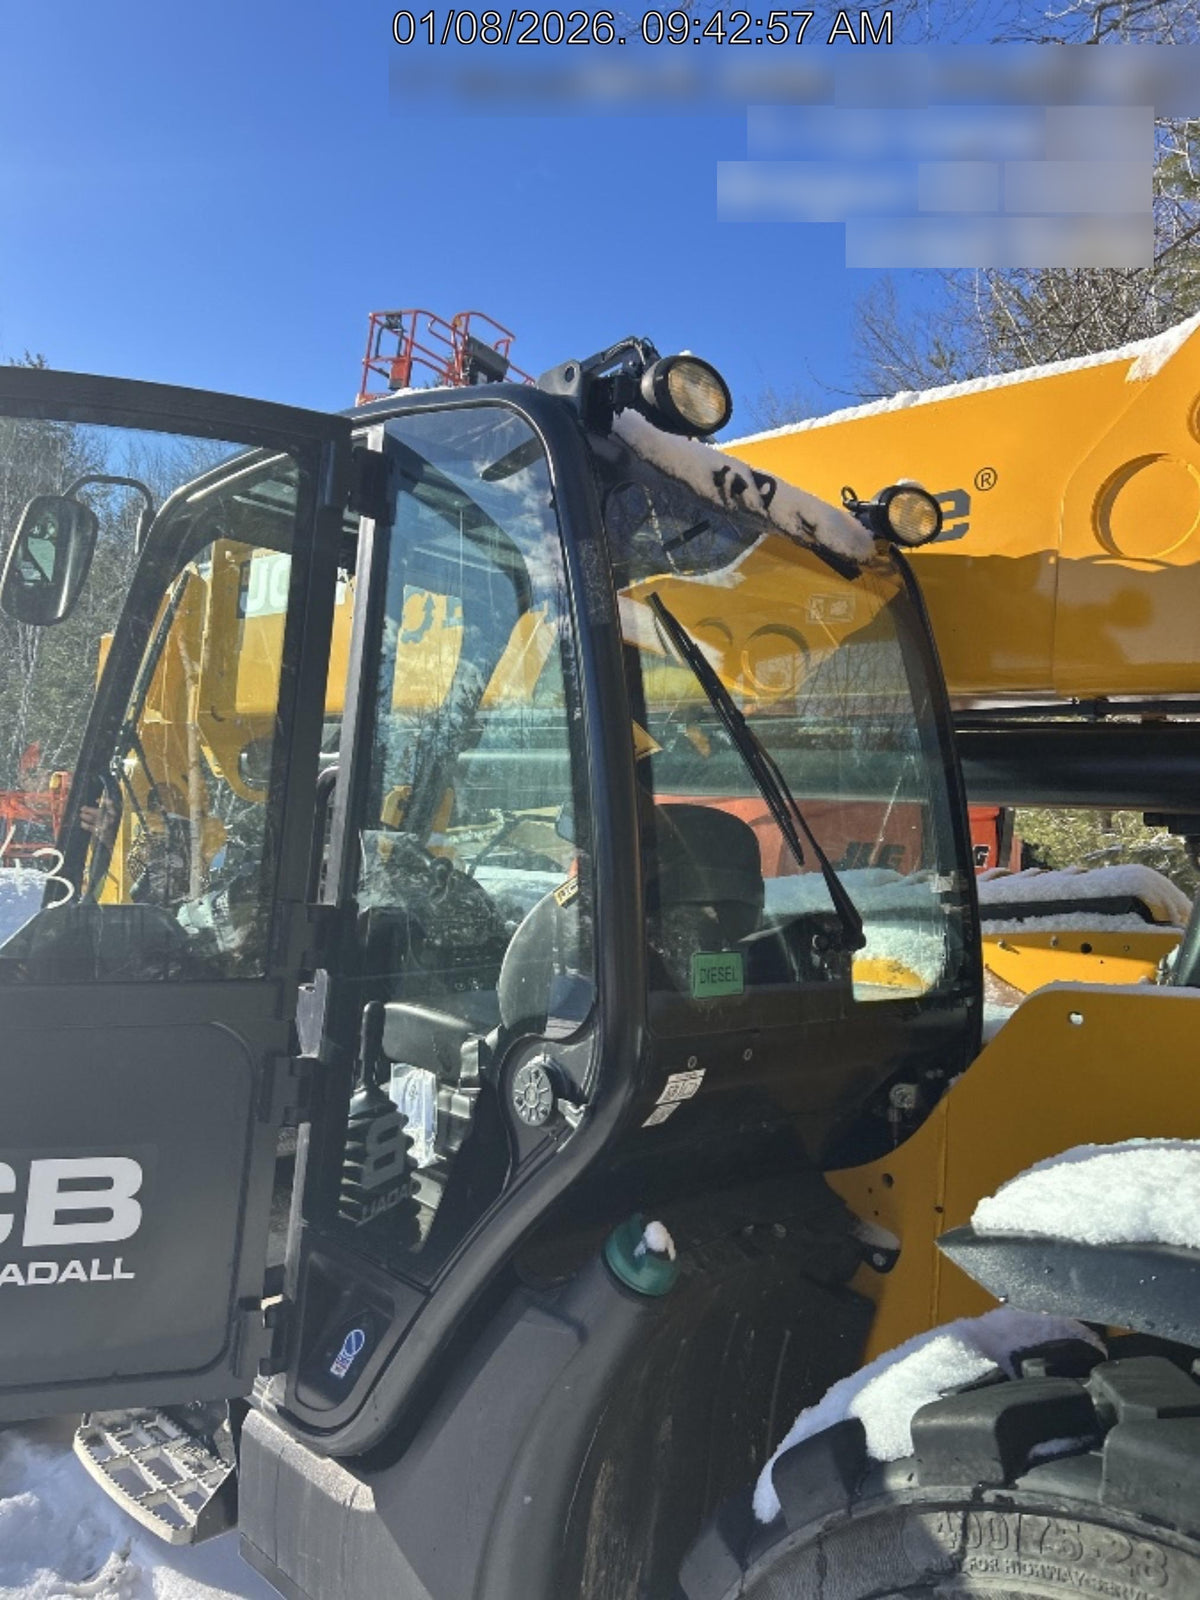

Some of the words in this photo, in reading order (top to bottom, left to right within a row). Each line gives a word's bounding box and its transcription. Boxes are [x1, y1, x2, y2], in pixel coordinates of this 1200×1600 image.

[700, 965, 738, 985] DIESEL
[0, 1157, 143, 1247] B
[0, 1257, 136, 1287] ADALL
